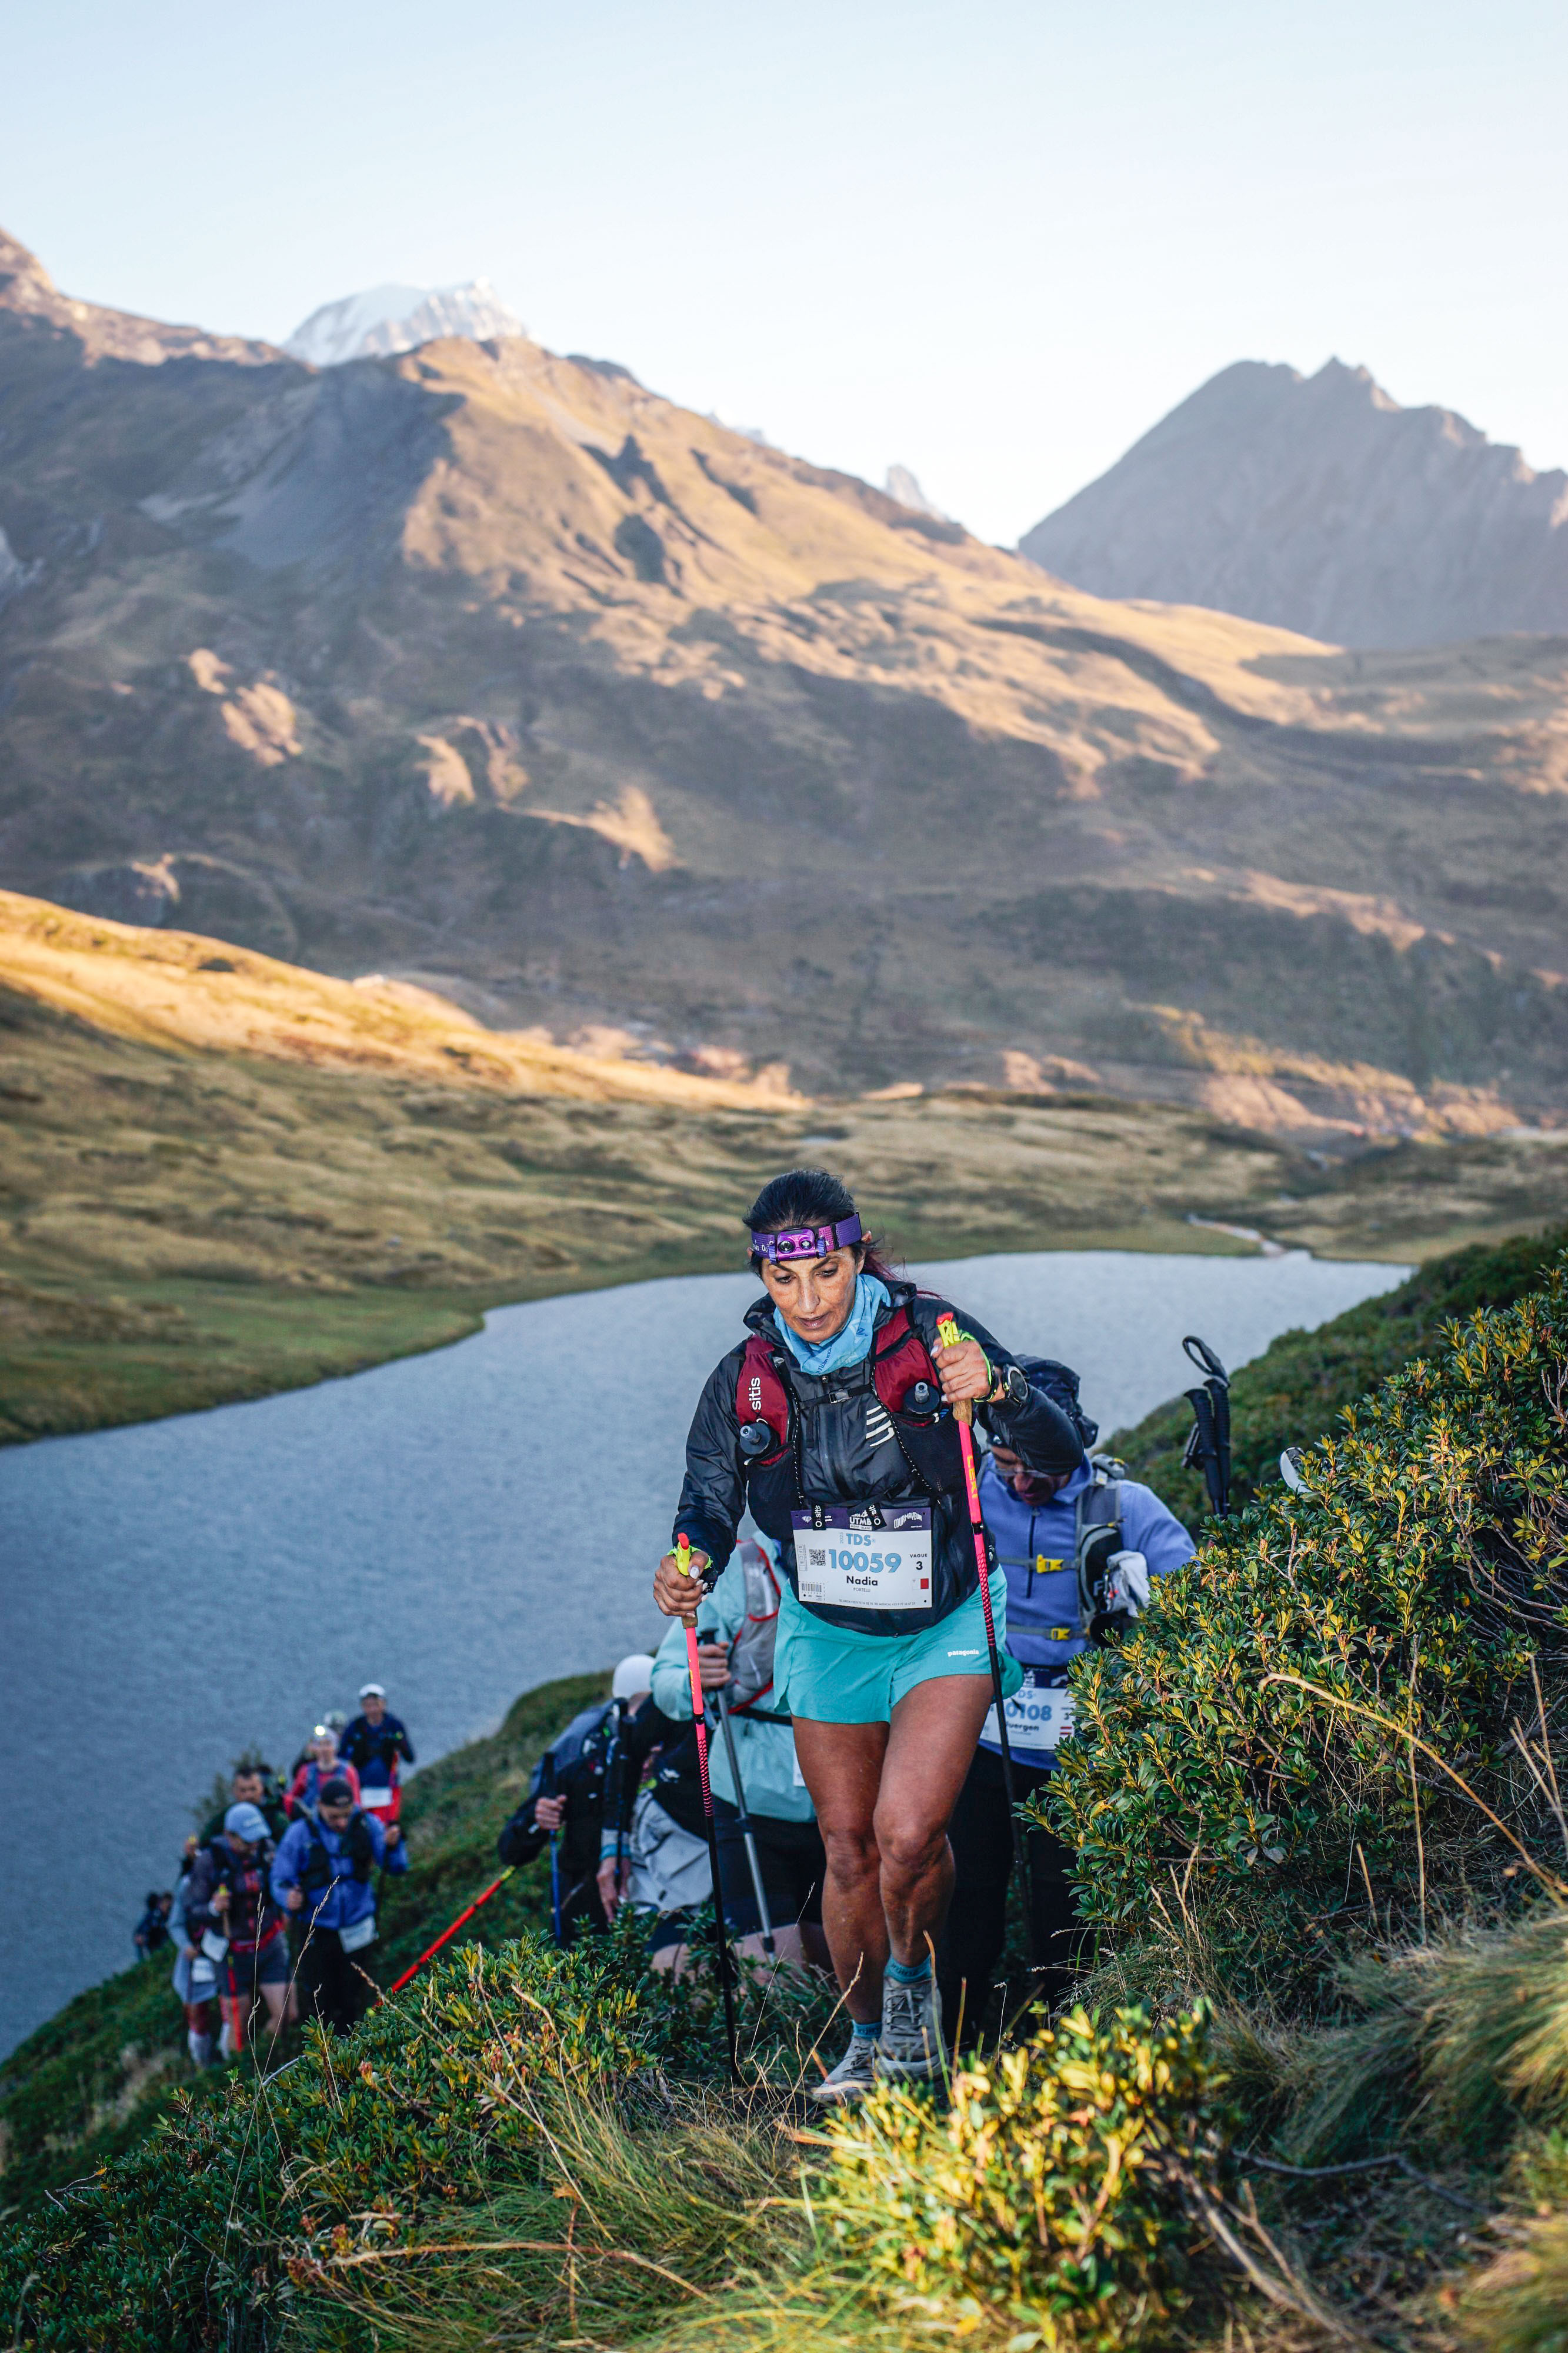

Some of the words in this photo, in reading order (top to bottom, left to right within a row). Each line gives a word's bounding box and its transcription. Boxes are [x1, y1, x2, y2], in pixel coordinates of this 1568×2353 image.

[967, 1455, 978, 1498] LEKI
[849, 1517, 872, 1525] UTMB
[893, 1512, 922, 1529] COURMAYEUR
[828, 1549, 902, 1573] 10059
[916, 1561, 923, 1570] 3
[846, 1575, 878, 1586] Nadia
[1018, 1689, 1033, 1699] DS
[1005, 1702, 1052, 1721] 0108
